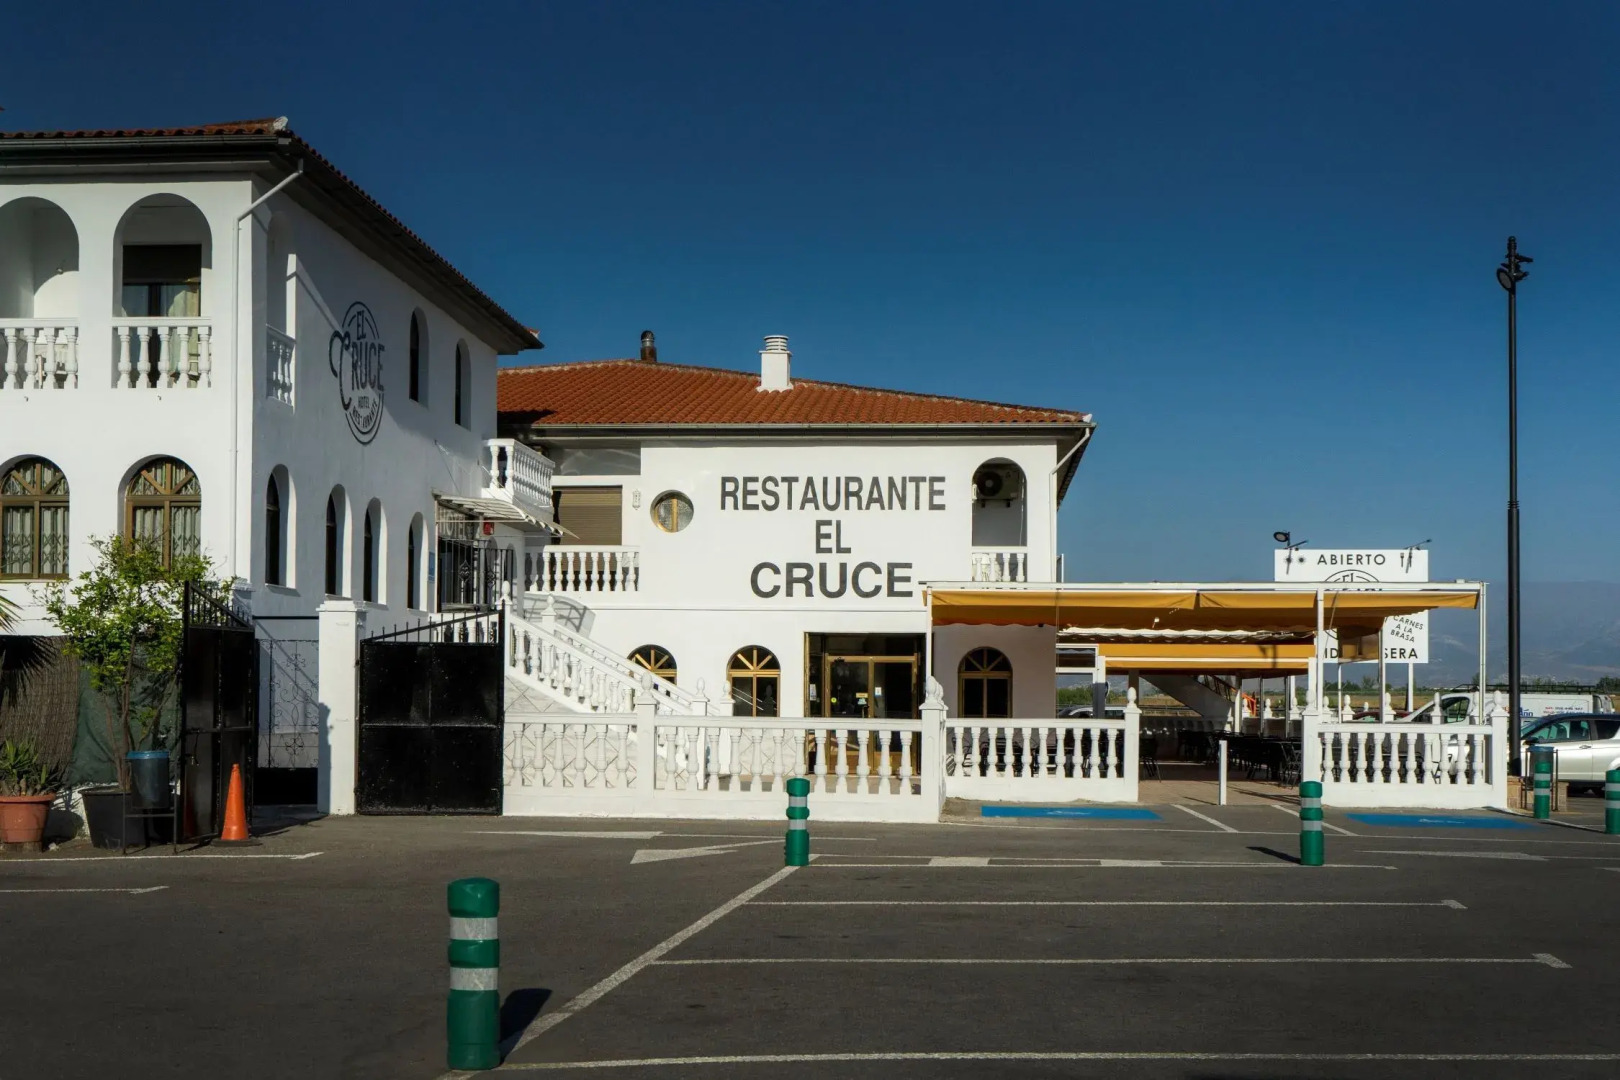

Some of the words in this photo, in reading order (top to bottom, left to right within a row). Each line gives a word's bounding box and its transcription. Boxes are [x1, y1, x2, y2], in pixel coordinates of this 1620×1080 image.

[356, 310, 367, 341] EL
[329, 330, 385, 411] CRUCE
[720, 475, 946, 511] RESTAURANTE
[815, 519, 852, 554] EL
[1317, 554, 1386, 565] ABIERTO
[750, 561, 913, 599] CRUCE
[1390, 629, 1415, 643] BRASA
[1393, 615, 1424, 630] CARNES
[1403, 626, 1413, 634] LA
